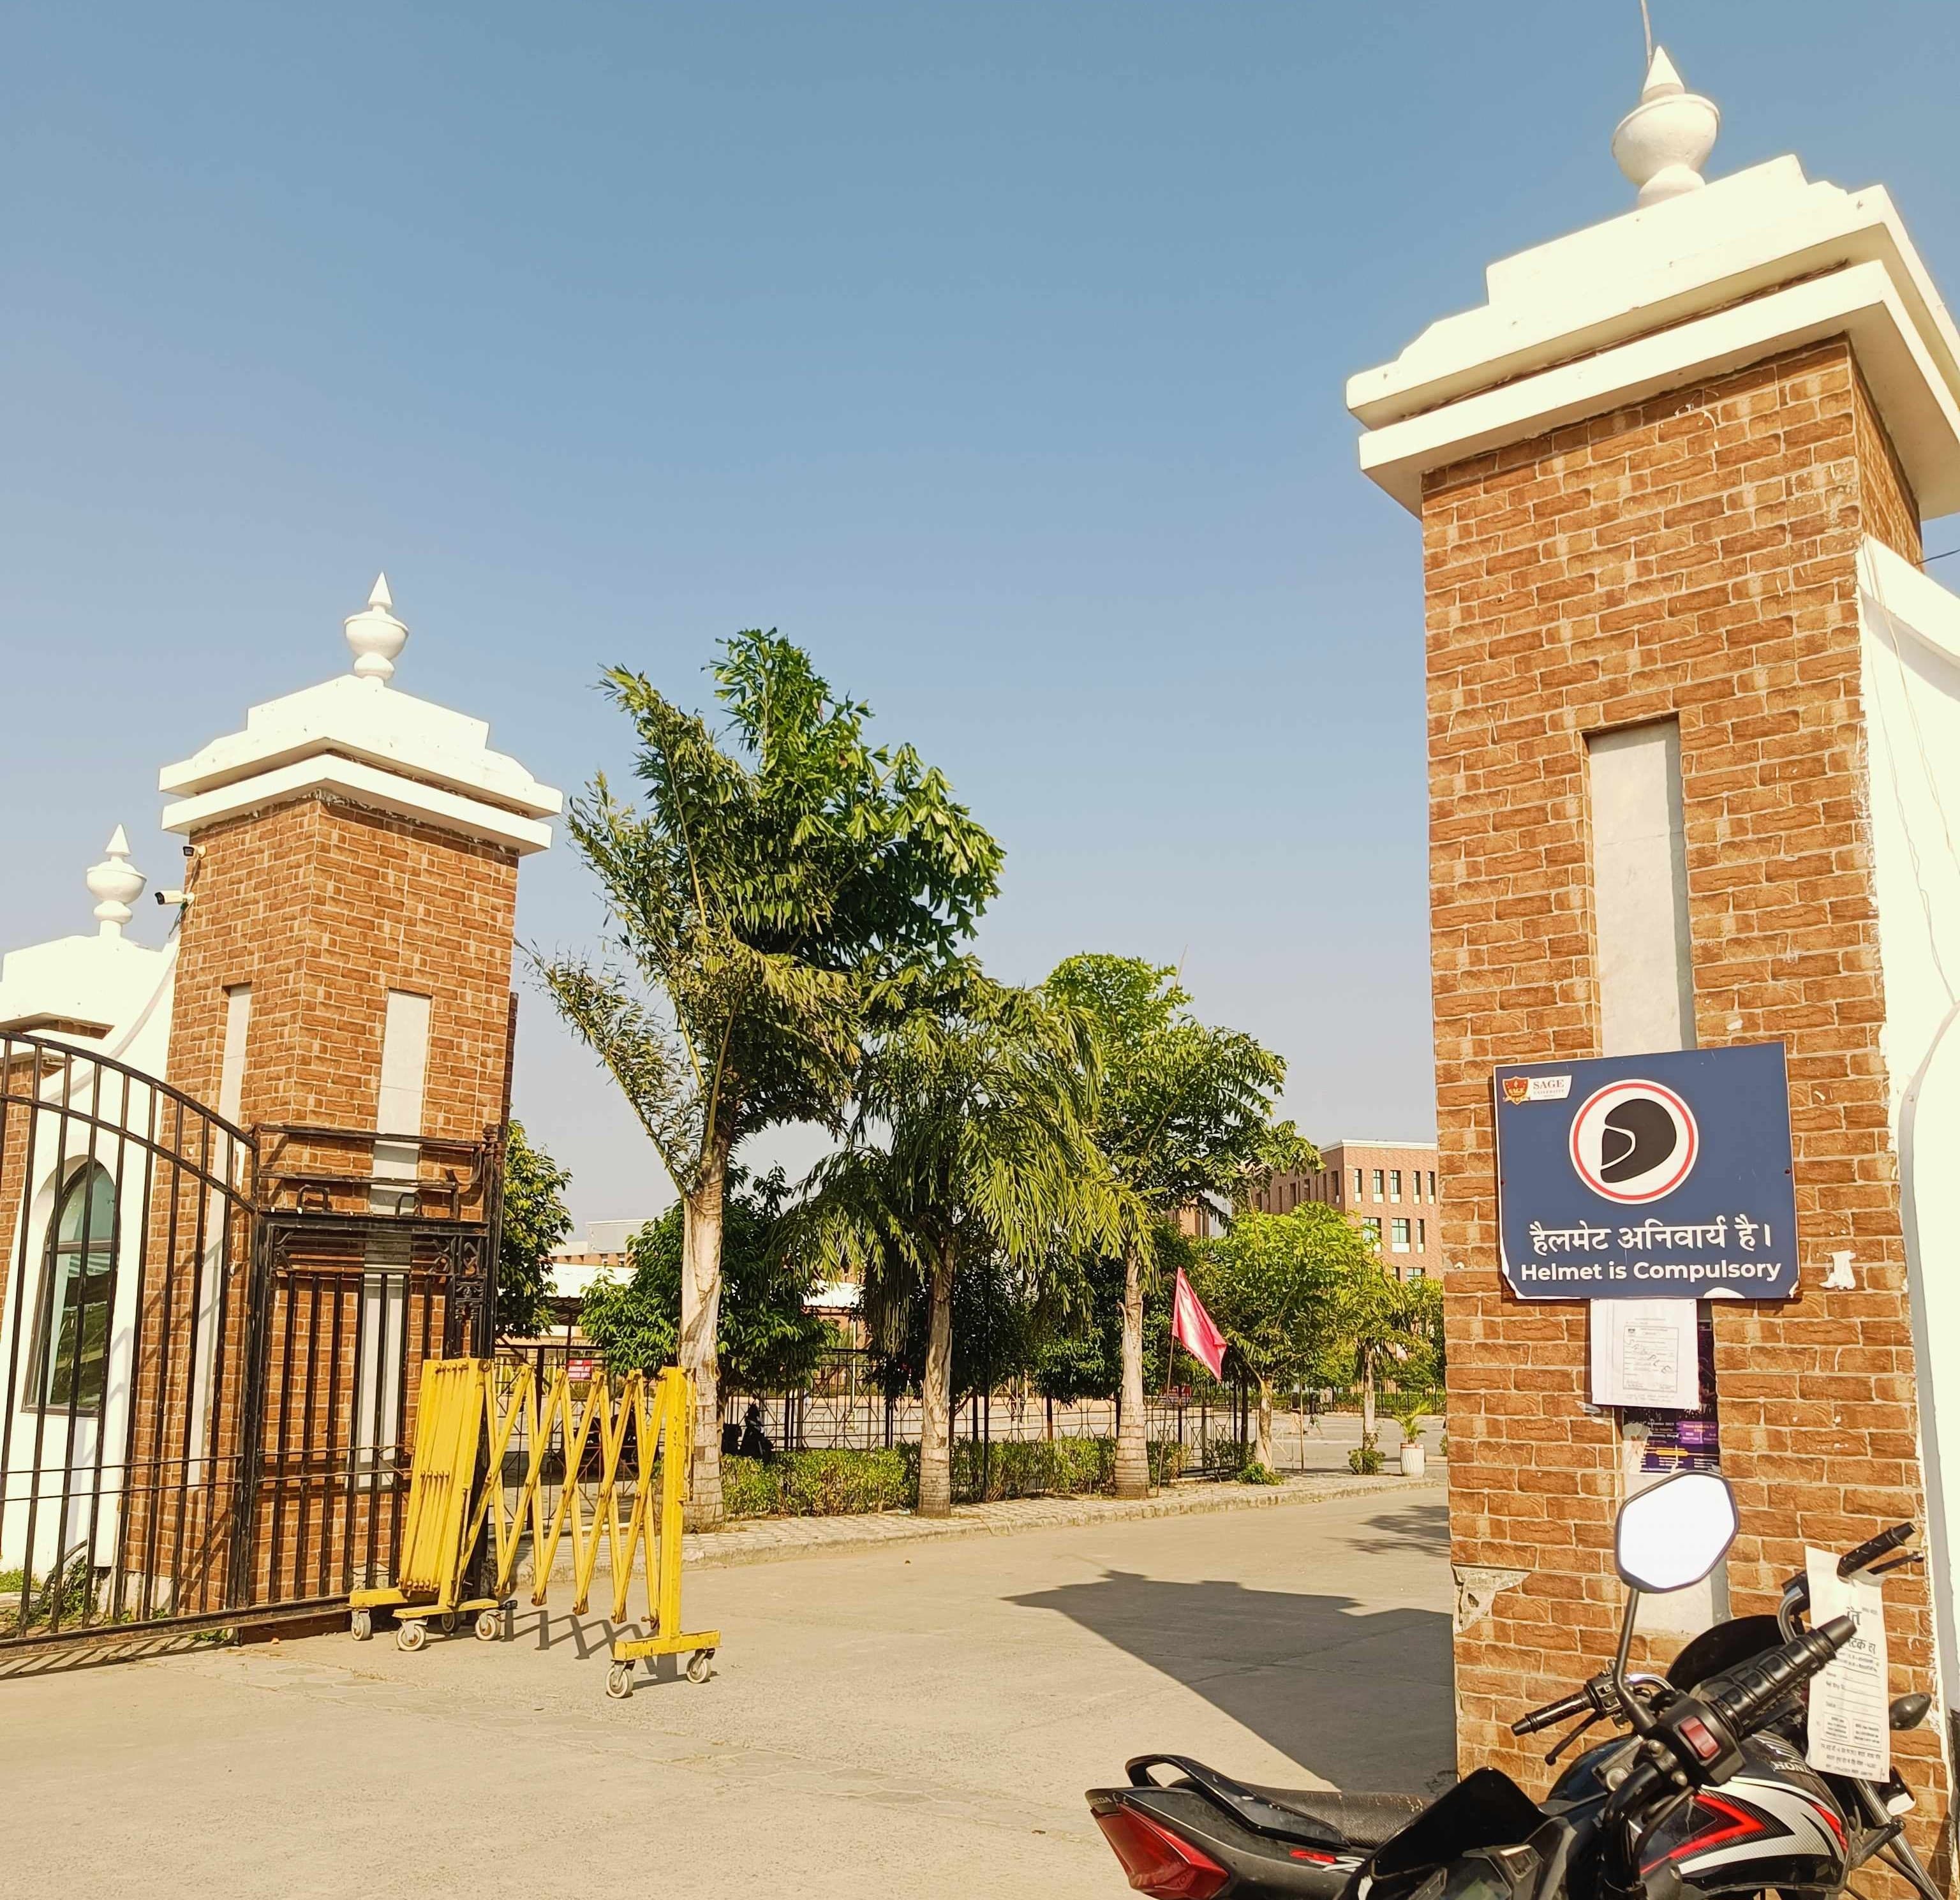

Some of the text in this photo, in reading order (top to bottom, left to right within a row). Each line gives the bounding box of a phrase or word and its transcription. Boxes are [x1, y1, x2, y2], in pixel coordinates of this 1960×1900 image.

[1533, 1079, 1565, 1090] SAGE
[1529, 1220, 1612, 1256] हैलमेट
[1617, 1215, 1728, 1251] अनिवार्य
[1521, 1259, 1781, 1282] Helmet is Compulsory
